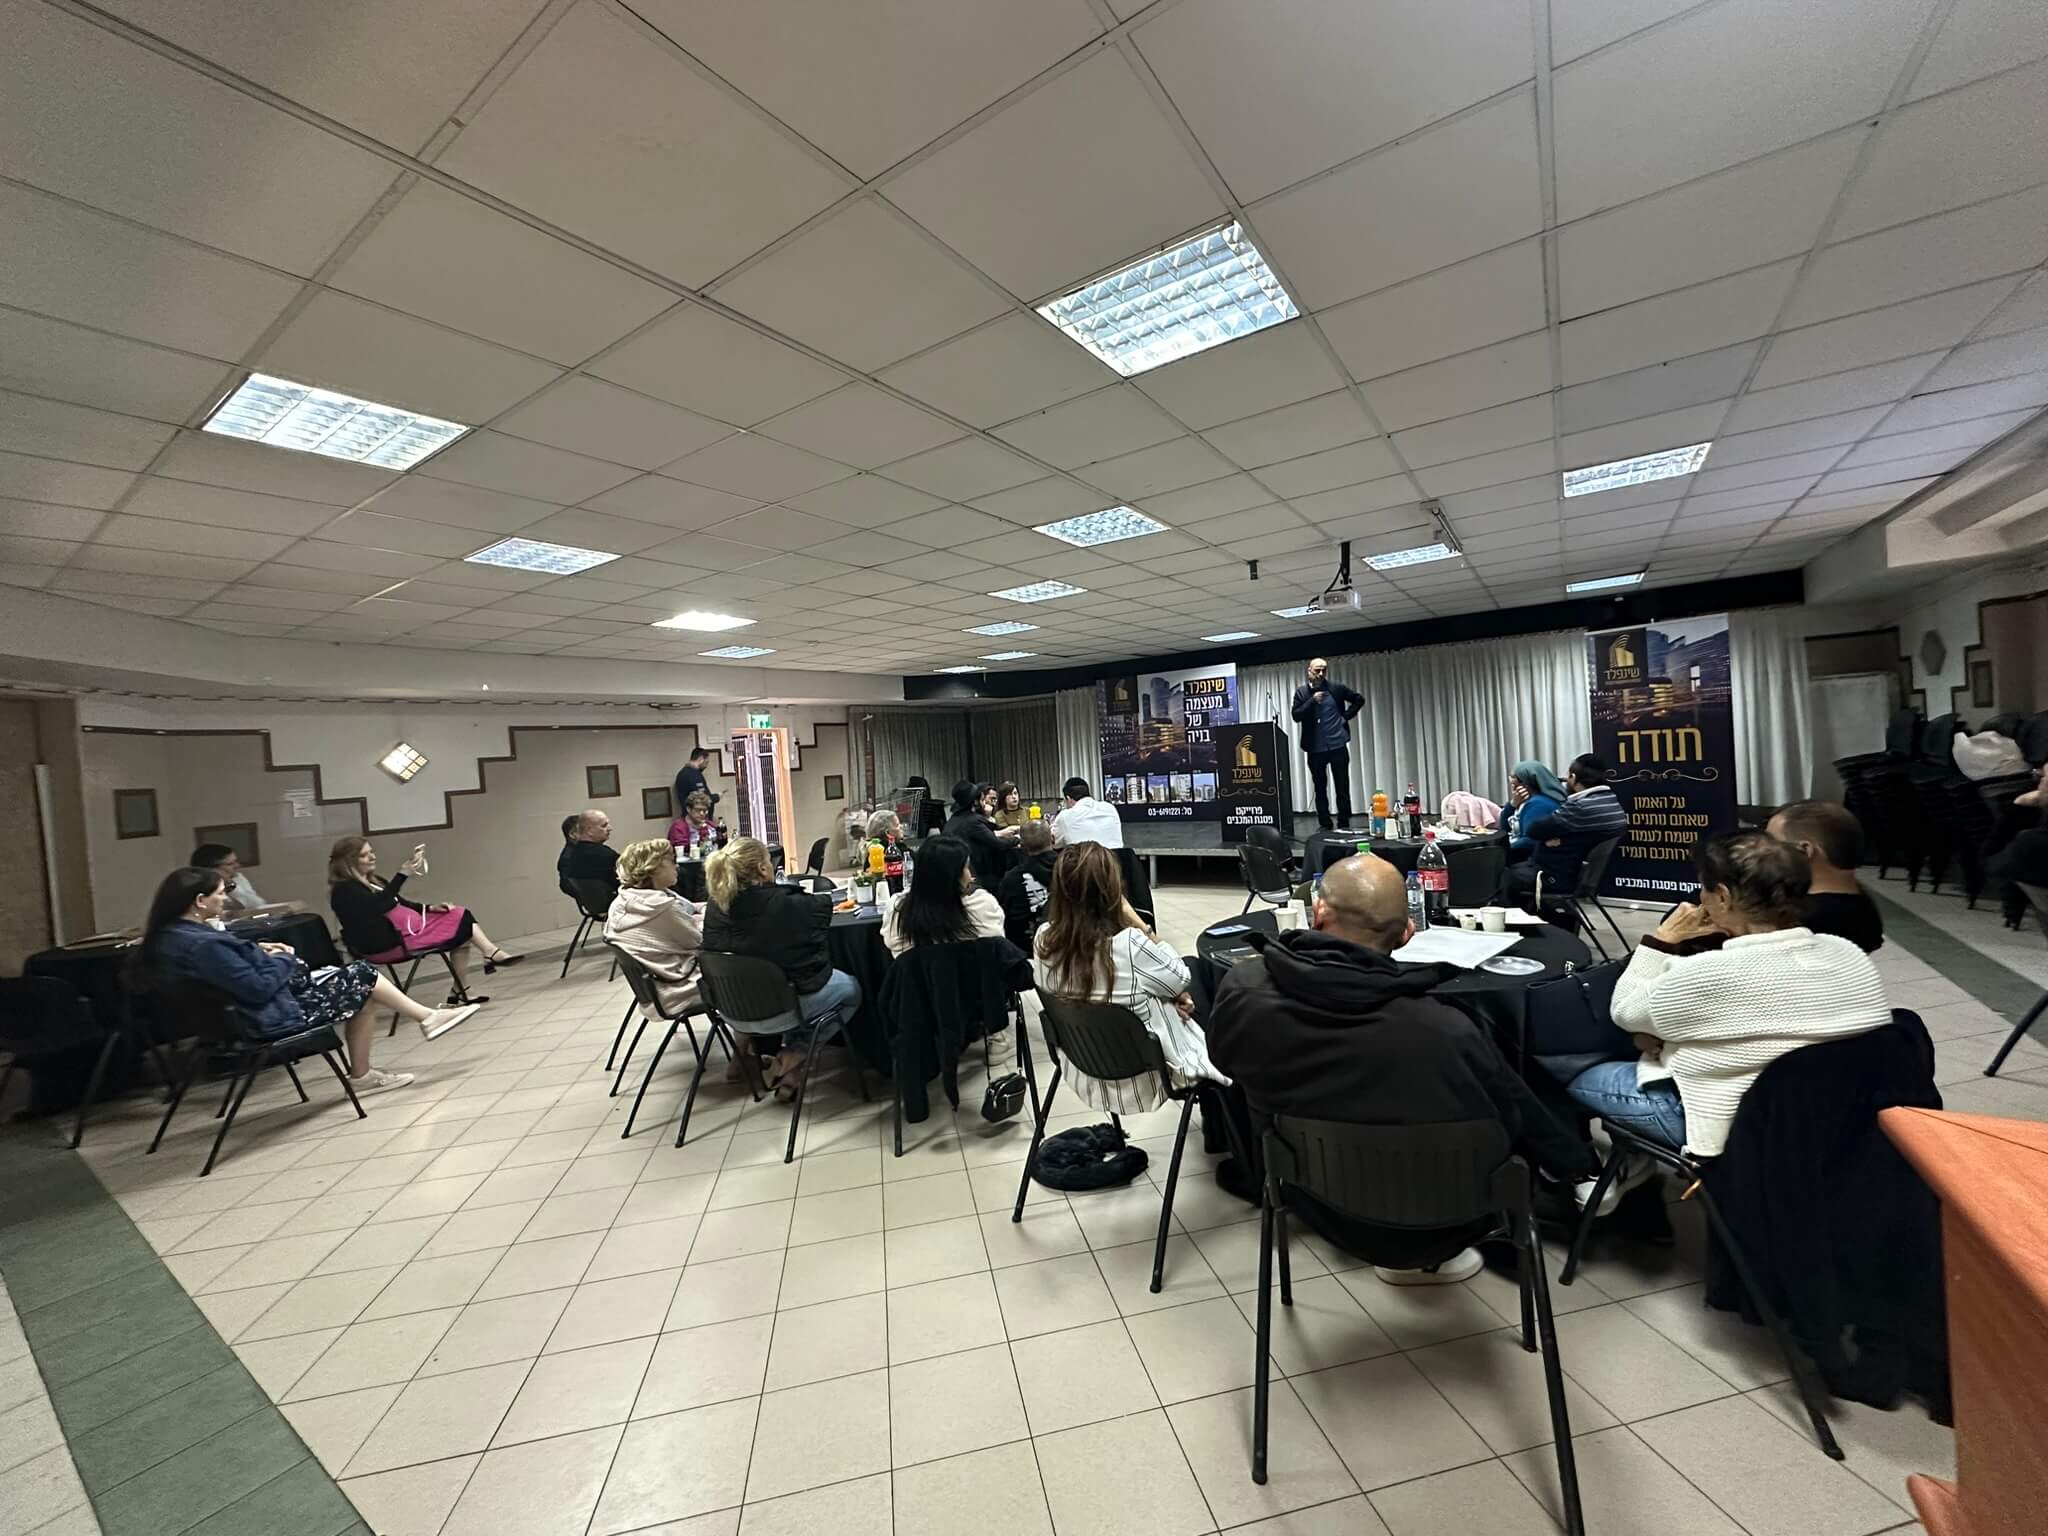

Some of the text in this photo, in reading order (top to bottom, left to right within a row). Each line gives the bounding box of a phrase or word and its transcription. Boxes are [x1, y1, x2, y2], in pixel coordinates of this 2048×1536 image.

[1603, 667, 1640, 680] שינפלד
[1185, 695, 1223, 711] מעצמה
[1186, 713, 1202, 727] של
[1187, 729, 1211, 743] בניה
[1617, 727, 1703, 763] תודה
[1231, 767, 1262, 779] שינפלד
[1633, 795, 1686, 810] על האמון
[1226, 815, 1274, 825] פסגת המכבים
[1632, 813, 1667, 826] נותנים
[1669, 814, 1709, 827] שאתם
[1628, 830, 1662, 842] לעמוד
[1618, 845, 1647, 859] תמיד
[1615, 877, 1650, 888] המכבים
[1651, 879, 1678, 891] פסגת
